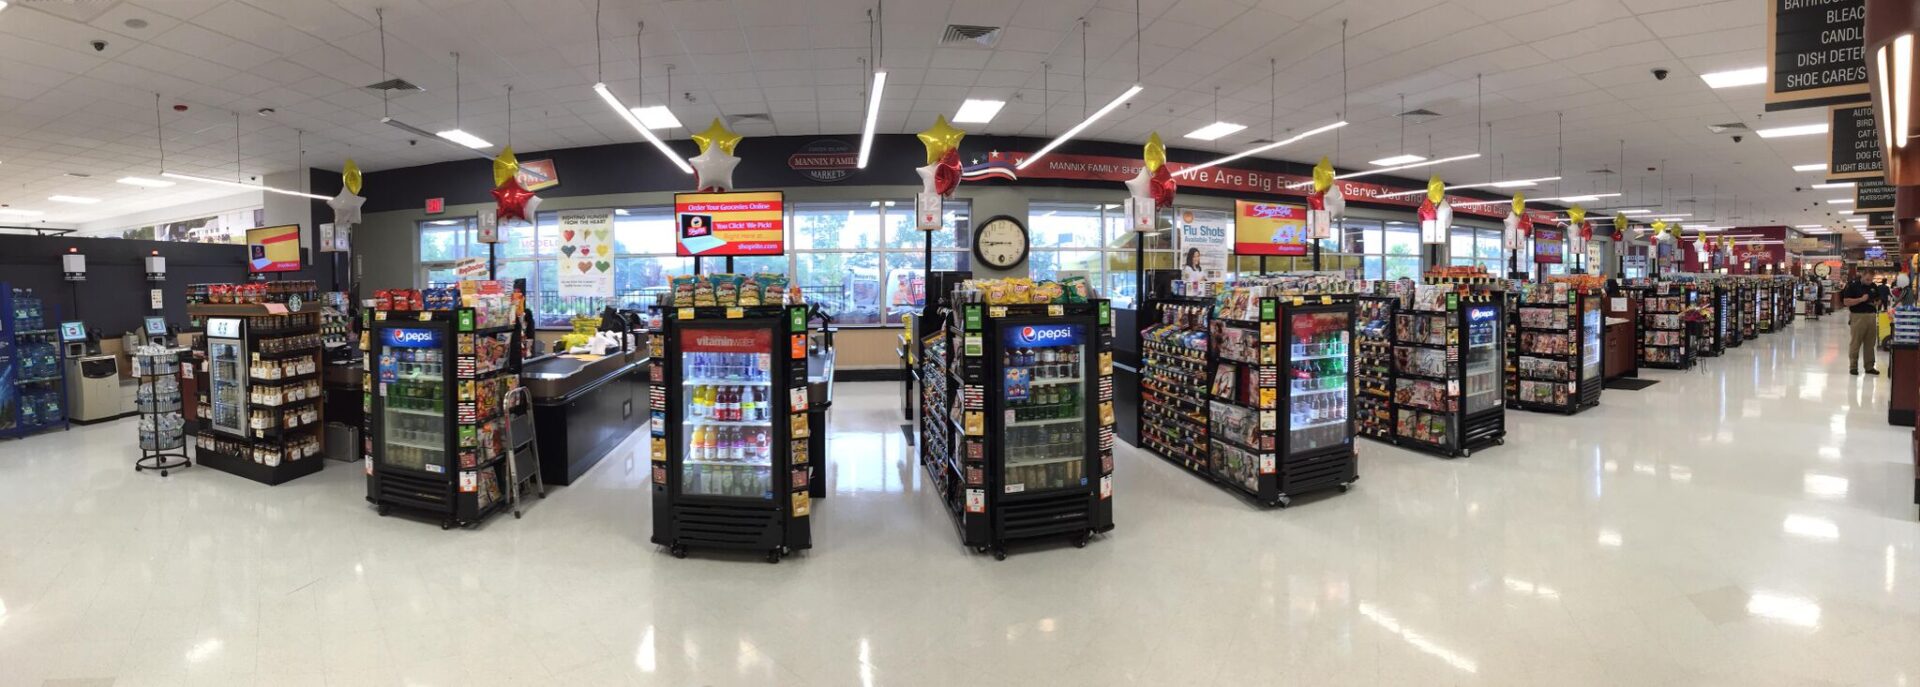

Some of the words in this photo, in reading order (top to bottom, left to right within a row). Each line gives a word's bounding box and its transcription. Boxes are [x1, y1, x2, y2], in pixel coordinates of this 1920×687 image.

[1826, 6, 1864, 23] BLEAC
[1821, 27, 1864, 44] CANDL
[1797, 51, 1826, 67] DISH
[1787, 72, 1819, 87] SHOE
[1822, 66, 1866, 83] CARE/S
[1853, 107, 1873, 117] AUTO
[1856, 119, 1873, 127] BIRD
[1857, 130, 1871, 138] CAT
[1872, 129, 1879, 137] F
[1855, 141, 1868, 149] CAT
[1870, 140, 1880, 148] LIT
[794, 157, 829, 165] MANNIX
[1856, 152, 1871, 160] DOG
[1872, 150, 1881, 158] FO
[1049, 162, 1086, 171] MANNIX
[1088, 163, 1119, 173] FAMILY
[1121, 166, 1142, 175] SHOP
[1836, 163, 1857, 172] LIGHT
[1858, 162, 1882, 171] BULB/E
[811, 170, 846, 179] MARKETS
[1180, 165, 1209, 182] We
[1214, 170, 1243, 186] Are
[1248, 173, 1272, 191] Big
[1277, 176, 1317, 195] Enoug
[1344, 183, 1378, 198] Serve
[1381, 187, 1401, 200] You
[1404, 191, 1423, 203] and
[921, 198, 939, 211] 12
[1483, 203, 1492, 213] to
[479, 212, 496, 227] 14
[1183, 224, 1197, 236] Flu
[1200, 225, 1225, 237] Shots
[1184, 235, 1208, 243] Available
[405, 331, 433, 342] pepsi
[1037, 327, 1072, 342] pepsi
[696, 335, 757, 347] vitaminwater
